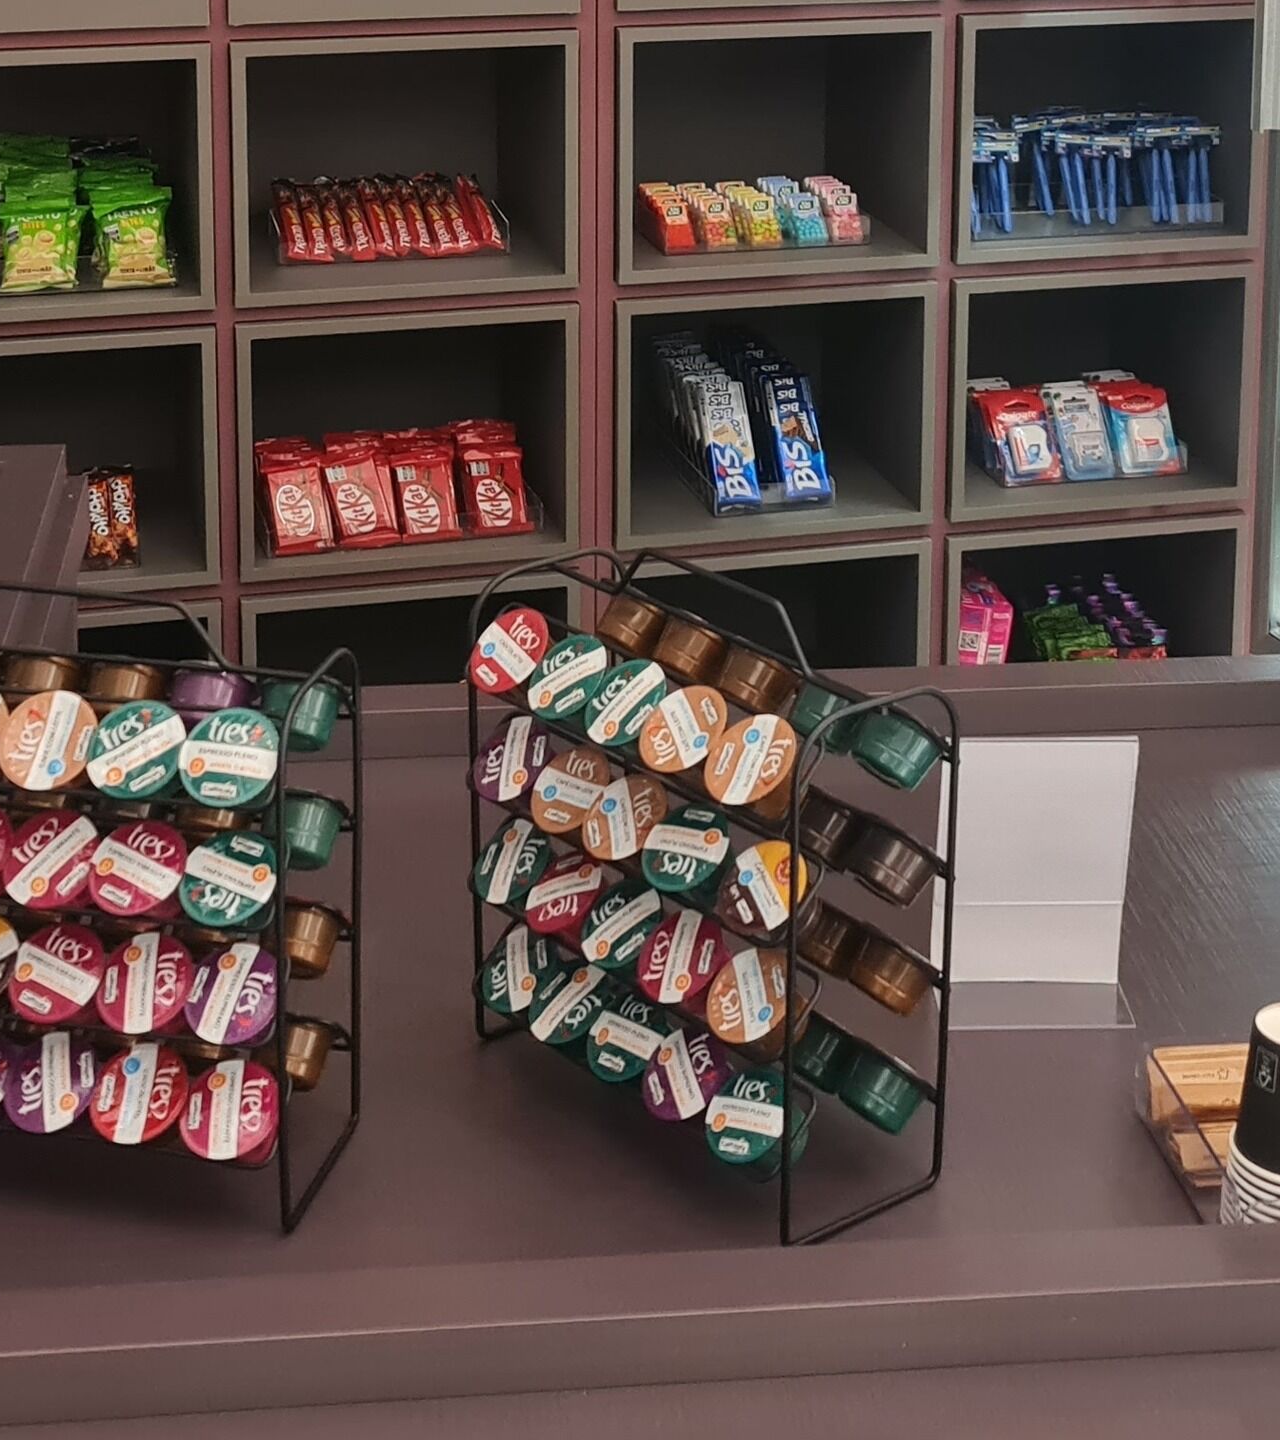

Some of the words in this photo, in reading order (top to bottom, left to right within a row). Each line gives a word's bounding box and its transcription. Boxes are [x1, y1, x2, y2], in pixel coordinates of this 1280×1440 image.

[1121, 401, 1155, 410] Colgate
[339, 483, 376, 533] KitKat
[406, 483, 439, 534] KitKat
[480, 478, 513, 526] KitKat
